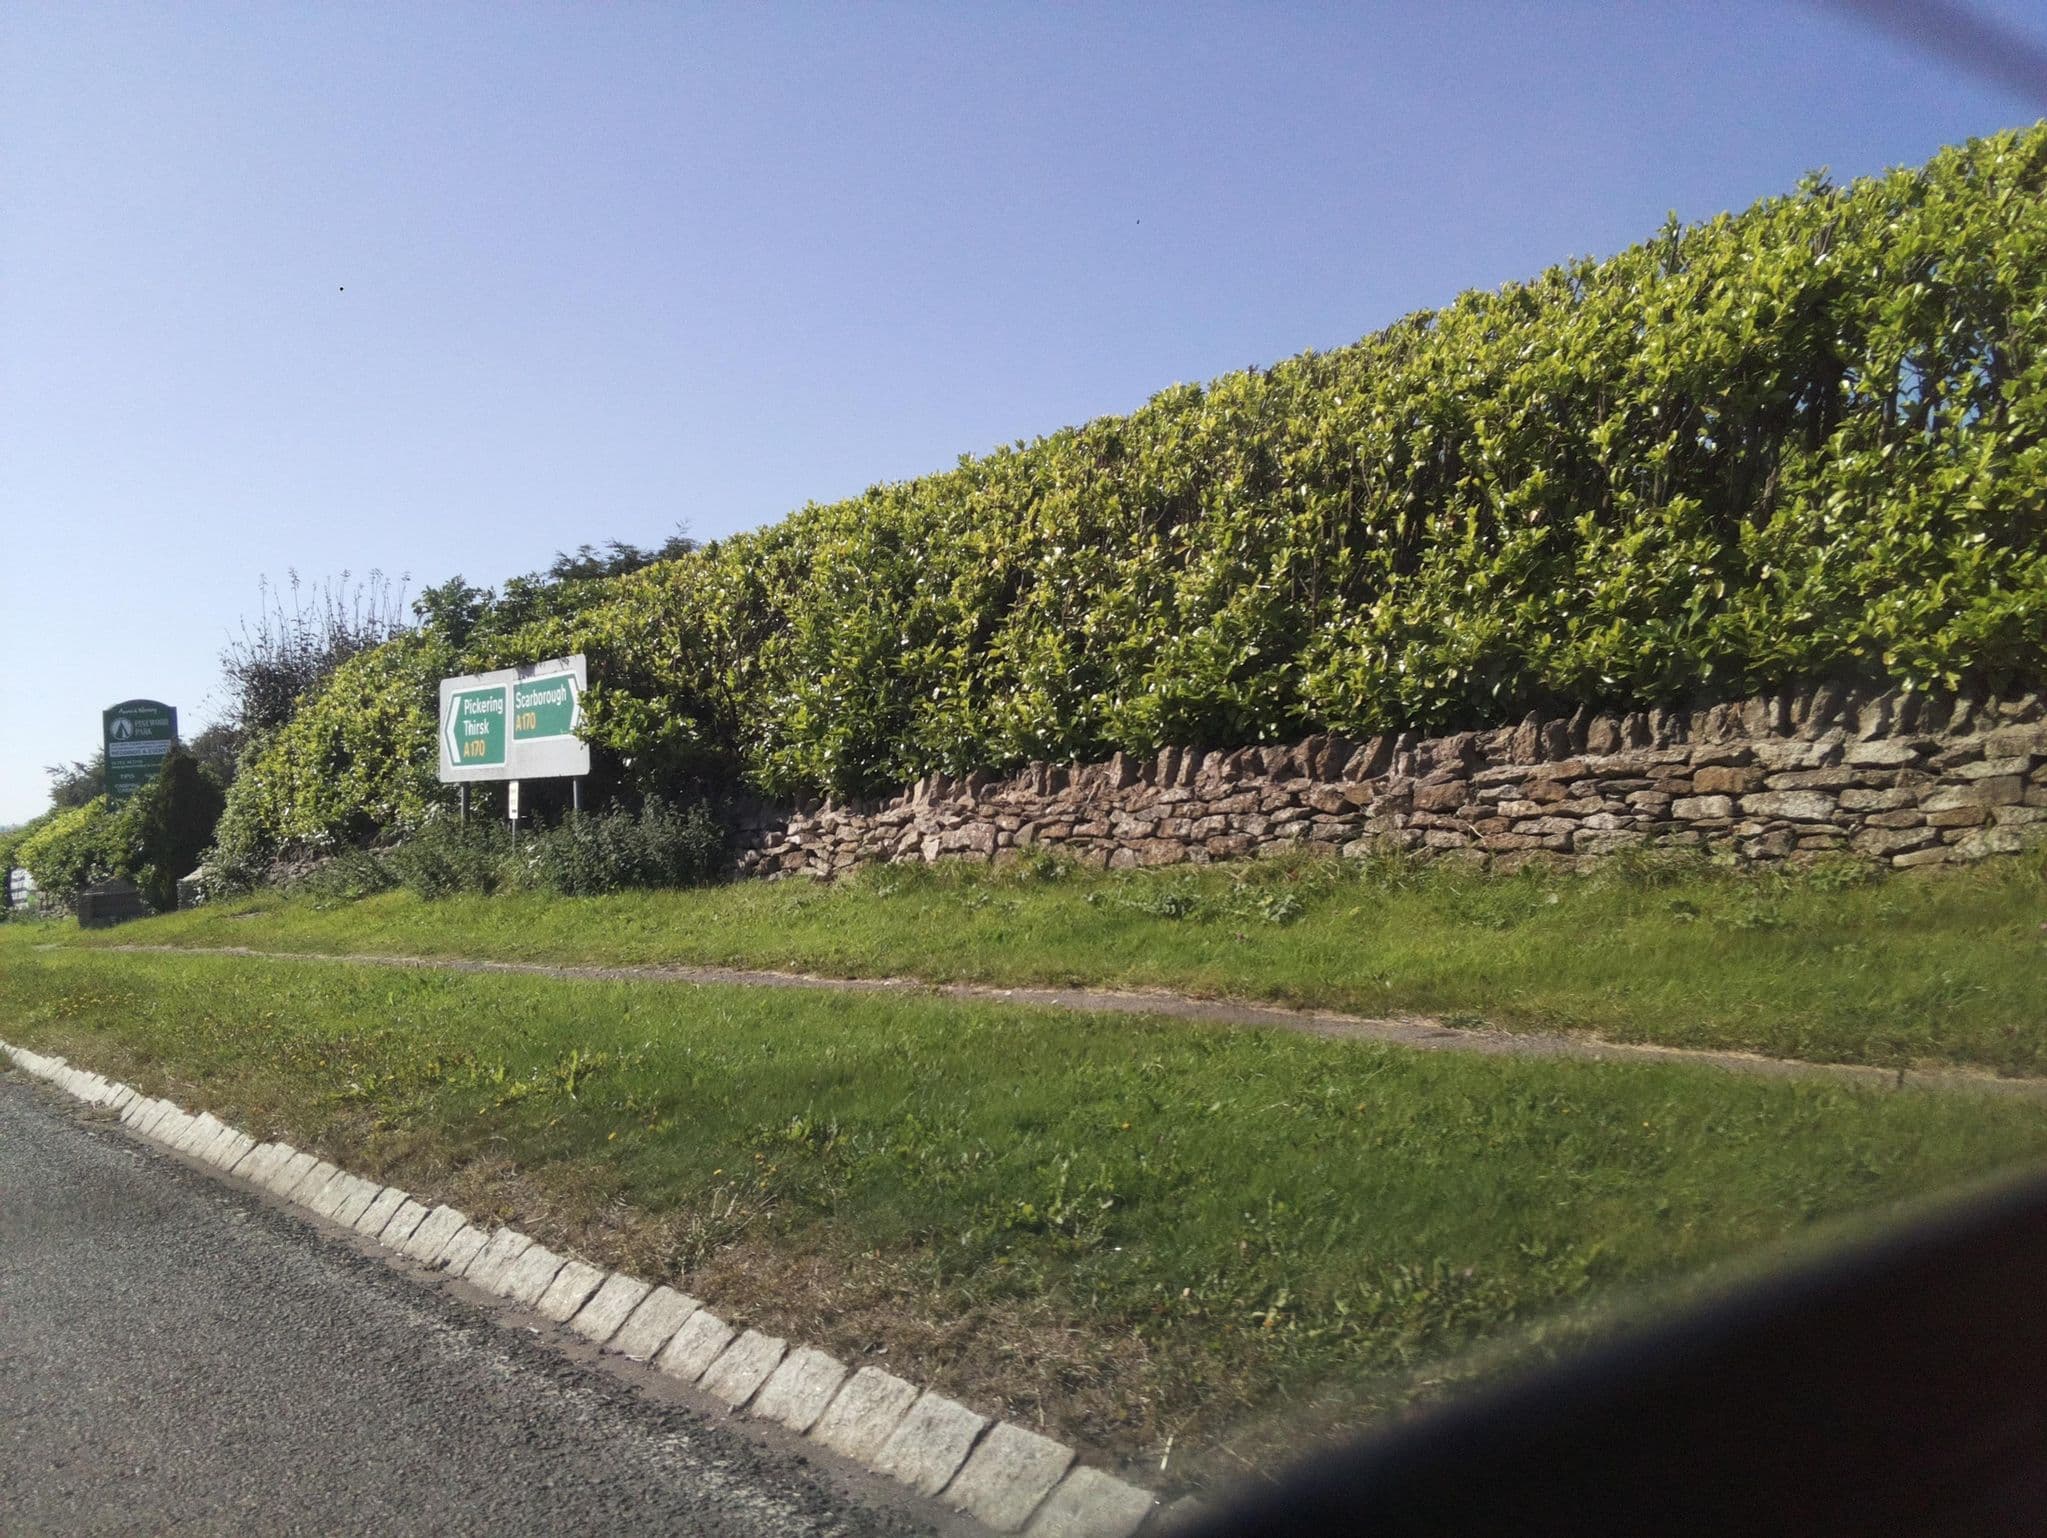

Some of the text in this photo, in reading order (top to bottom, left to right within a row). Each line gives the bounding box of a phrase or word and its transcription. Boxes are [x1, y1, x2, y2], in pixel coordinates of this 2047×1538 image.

[464, 696, 503, 715] Pickering
[515, 684, 567, 709] Scarborough
[463, 719, 490, 736] Thirsk
[515, 712, 536, 731] A170
[463, 740, 486, 758] A170
